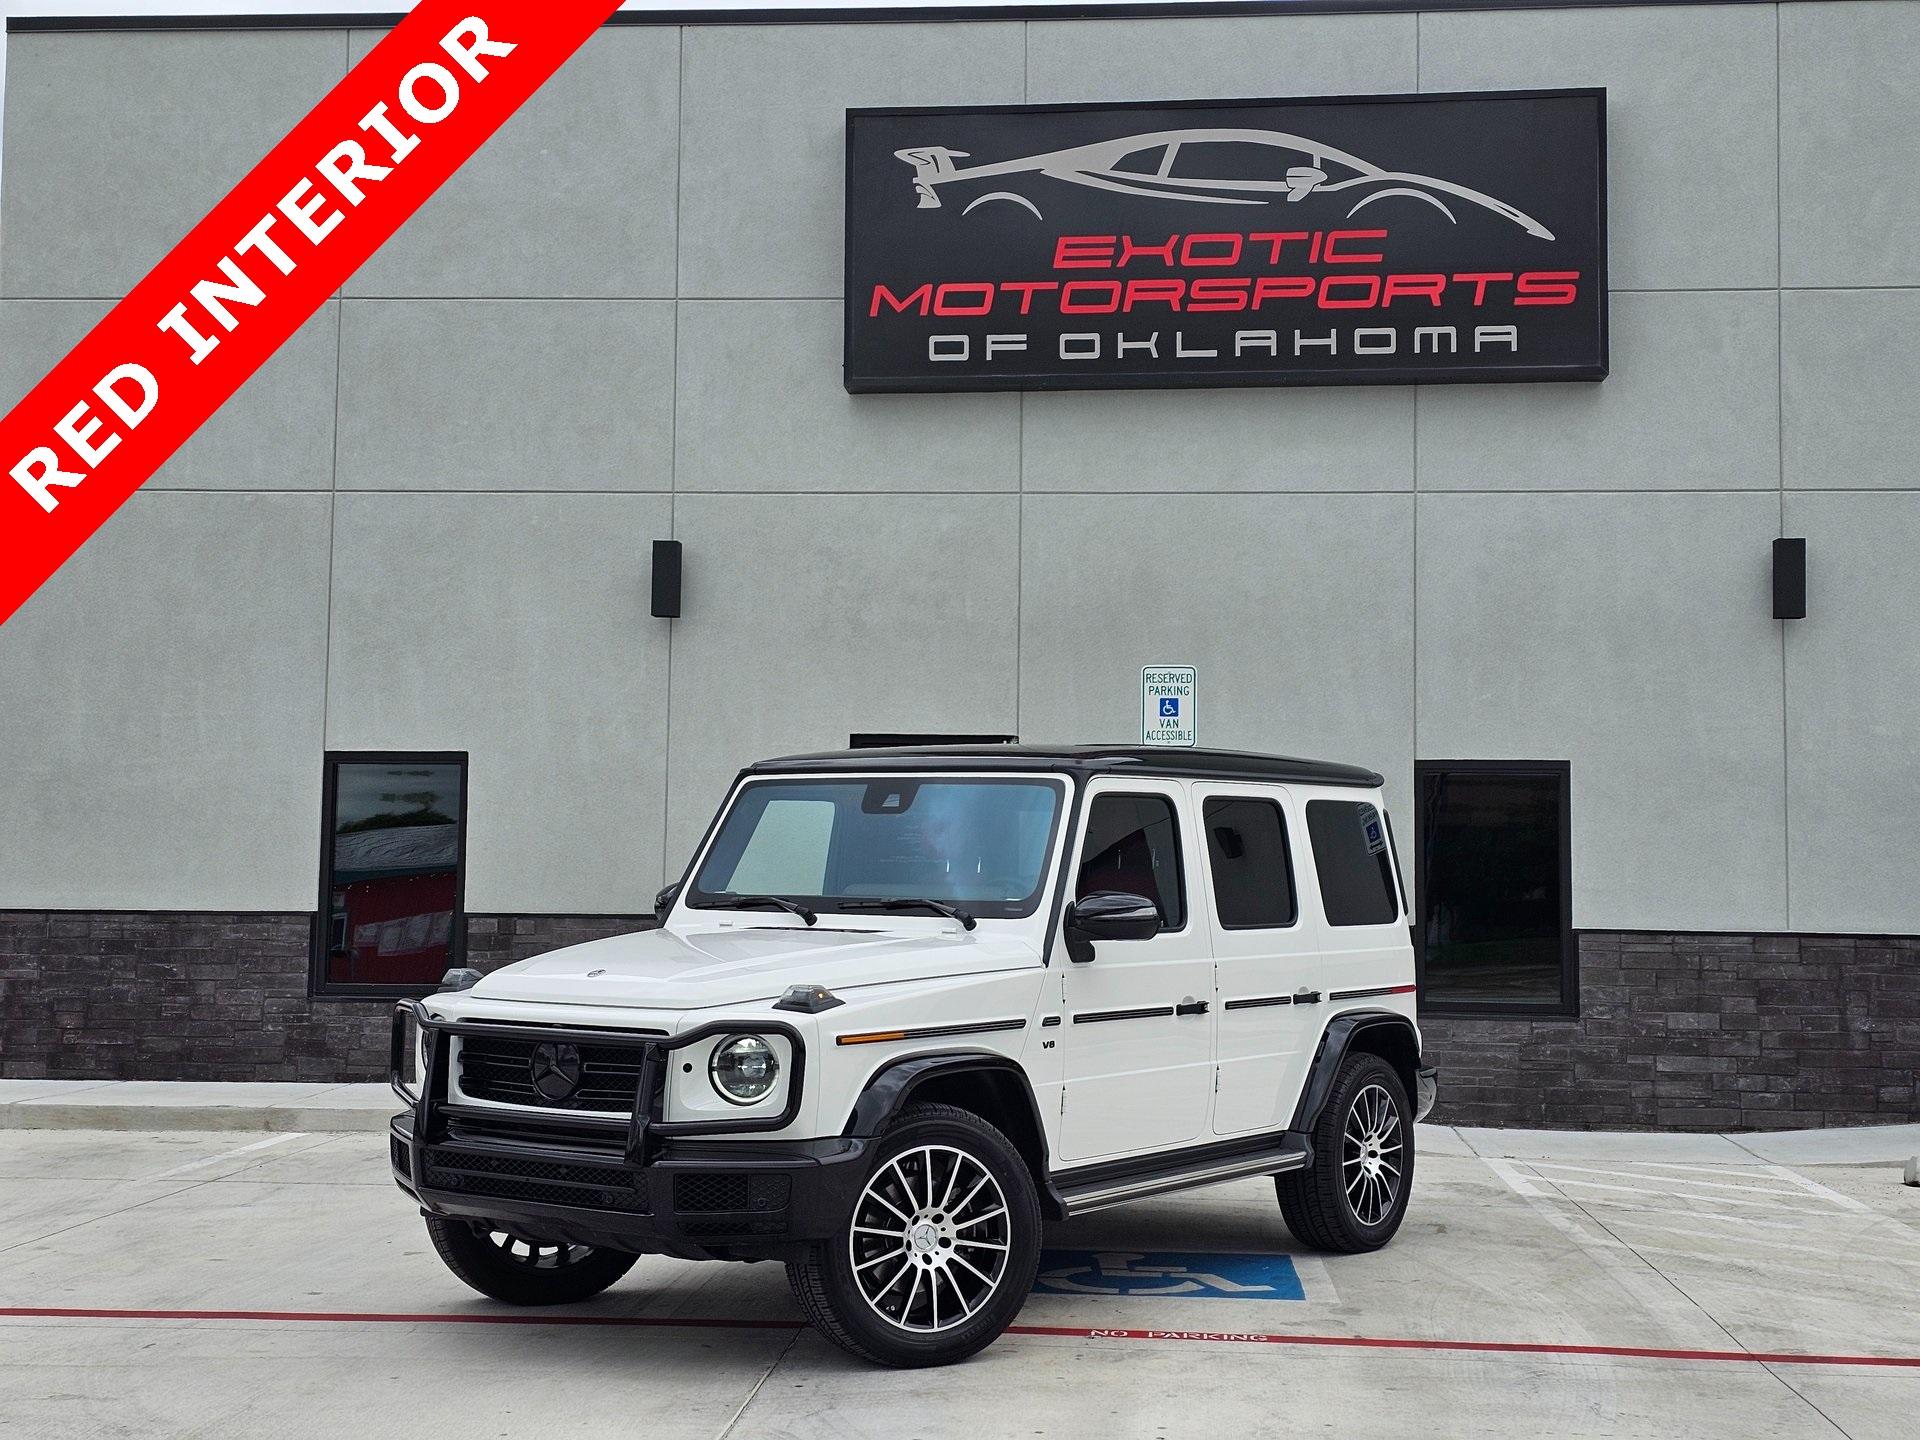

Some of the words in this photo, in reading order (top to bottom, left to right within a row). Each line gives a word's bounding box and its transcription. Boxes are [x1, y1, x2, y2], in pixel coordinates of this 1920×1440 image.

[1053, 229, 1388, 269] EXOTIC
[870, 270, 1581, 318] MOTORSPORTS
[929, 333, 1028, 362] OF
[1060, 325, 1519, 361] OKLAHOMA
[1145, 673, 1193, 684] RESERVED
[1148, 685, 1190, 696] PARKING
[1159, 718, 1179, 729] VAN
[1145, 730, 1192, 741] ACCESSIBLE
[1042, 1040, 1055, 1049] V8
[1090, 1329, 1128, 1337] NO
[1147, 1331, 1268, 1342] PARKING
